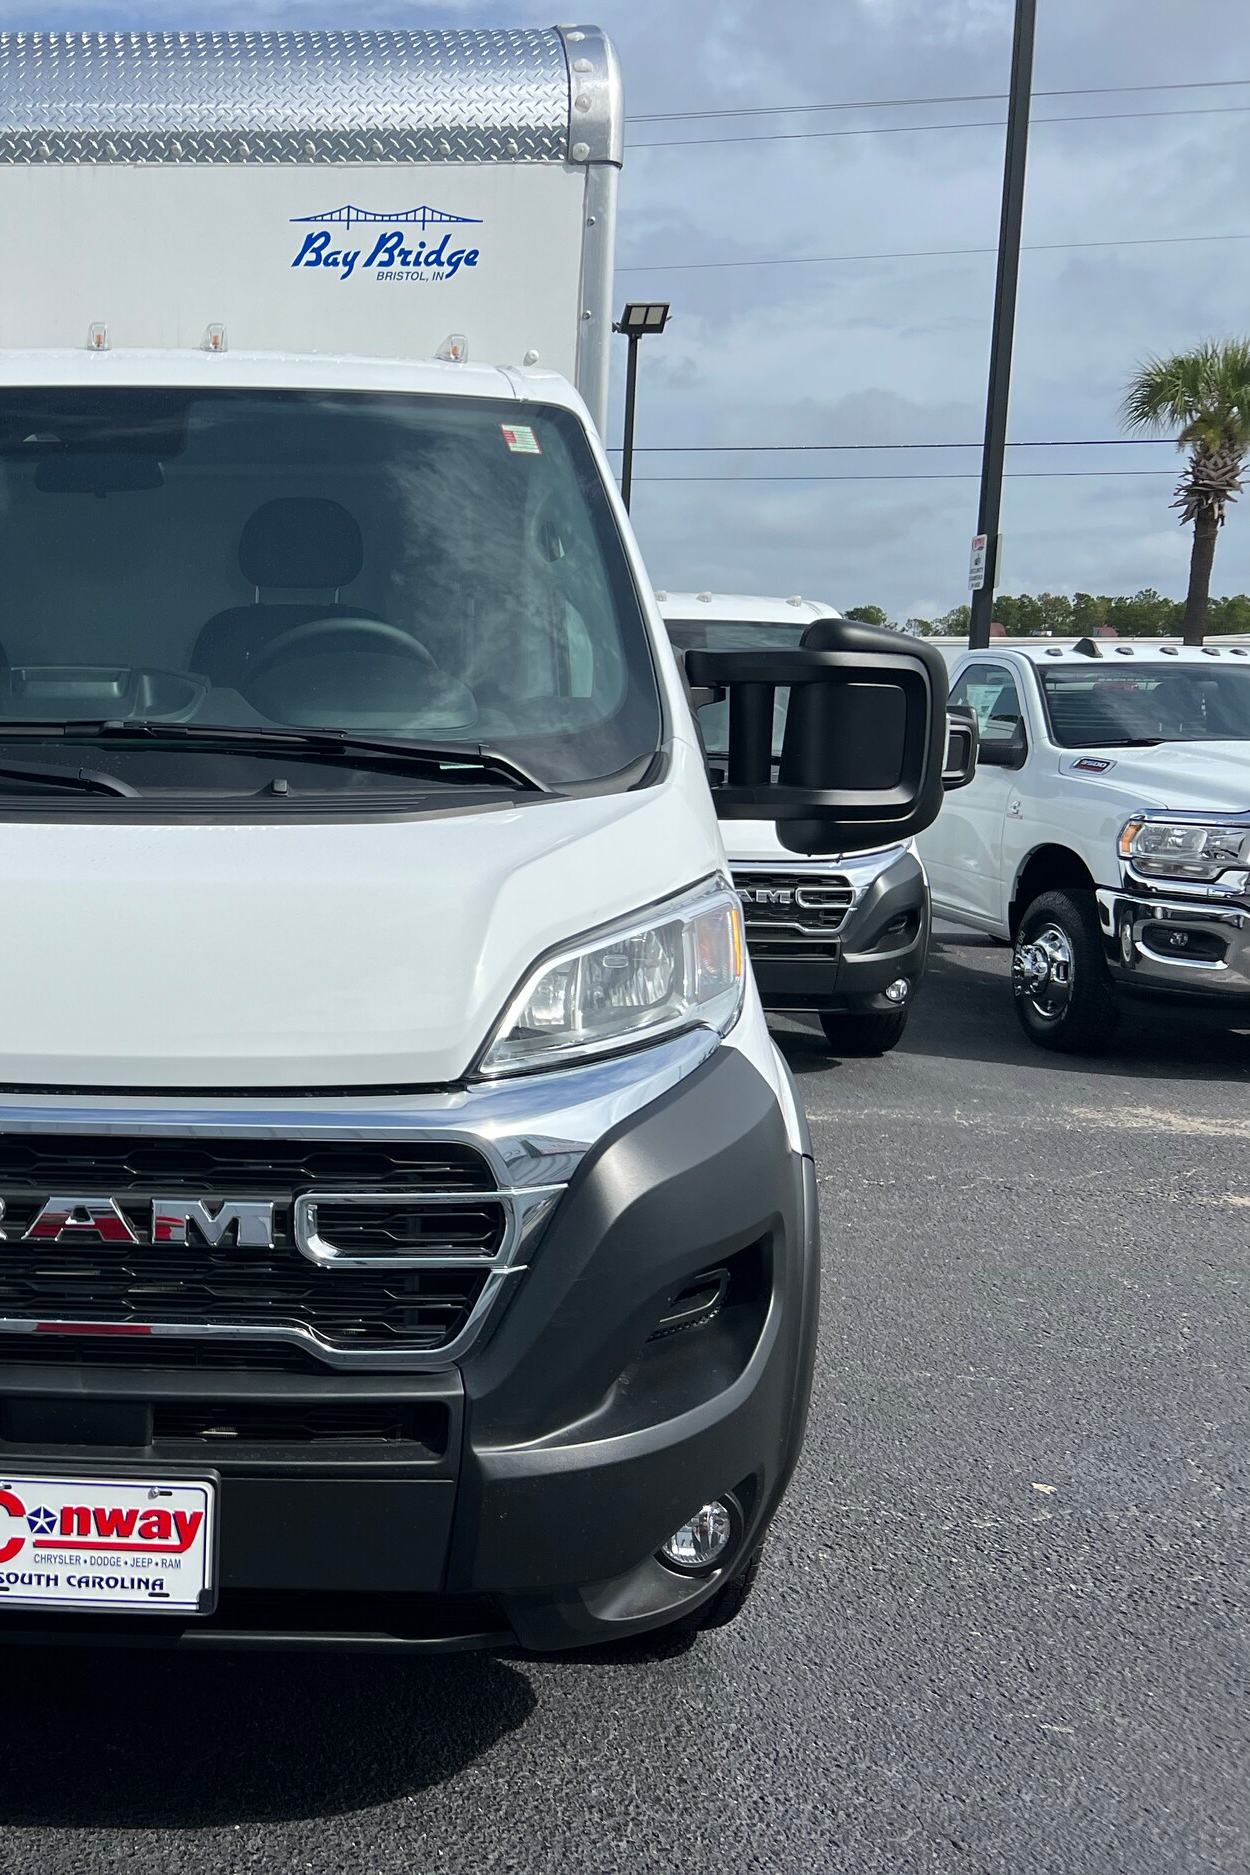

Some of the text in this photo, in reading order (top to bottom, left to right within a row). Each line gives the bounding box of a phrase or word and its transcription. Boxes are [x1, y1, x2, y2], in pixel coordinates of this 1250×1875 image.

[291, 230, 480, 281] Bay Bridge
[376, 271, 445, 283] BRISTOL, IN
[33, 1553, 182, 1569] CHRYSLER DODGE JEEP RAM
[66, 1574, 165, 1591] CAROLINA
